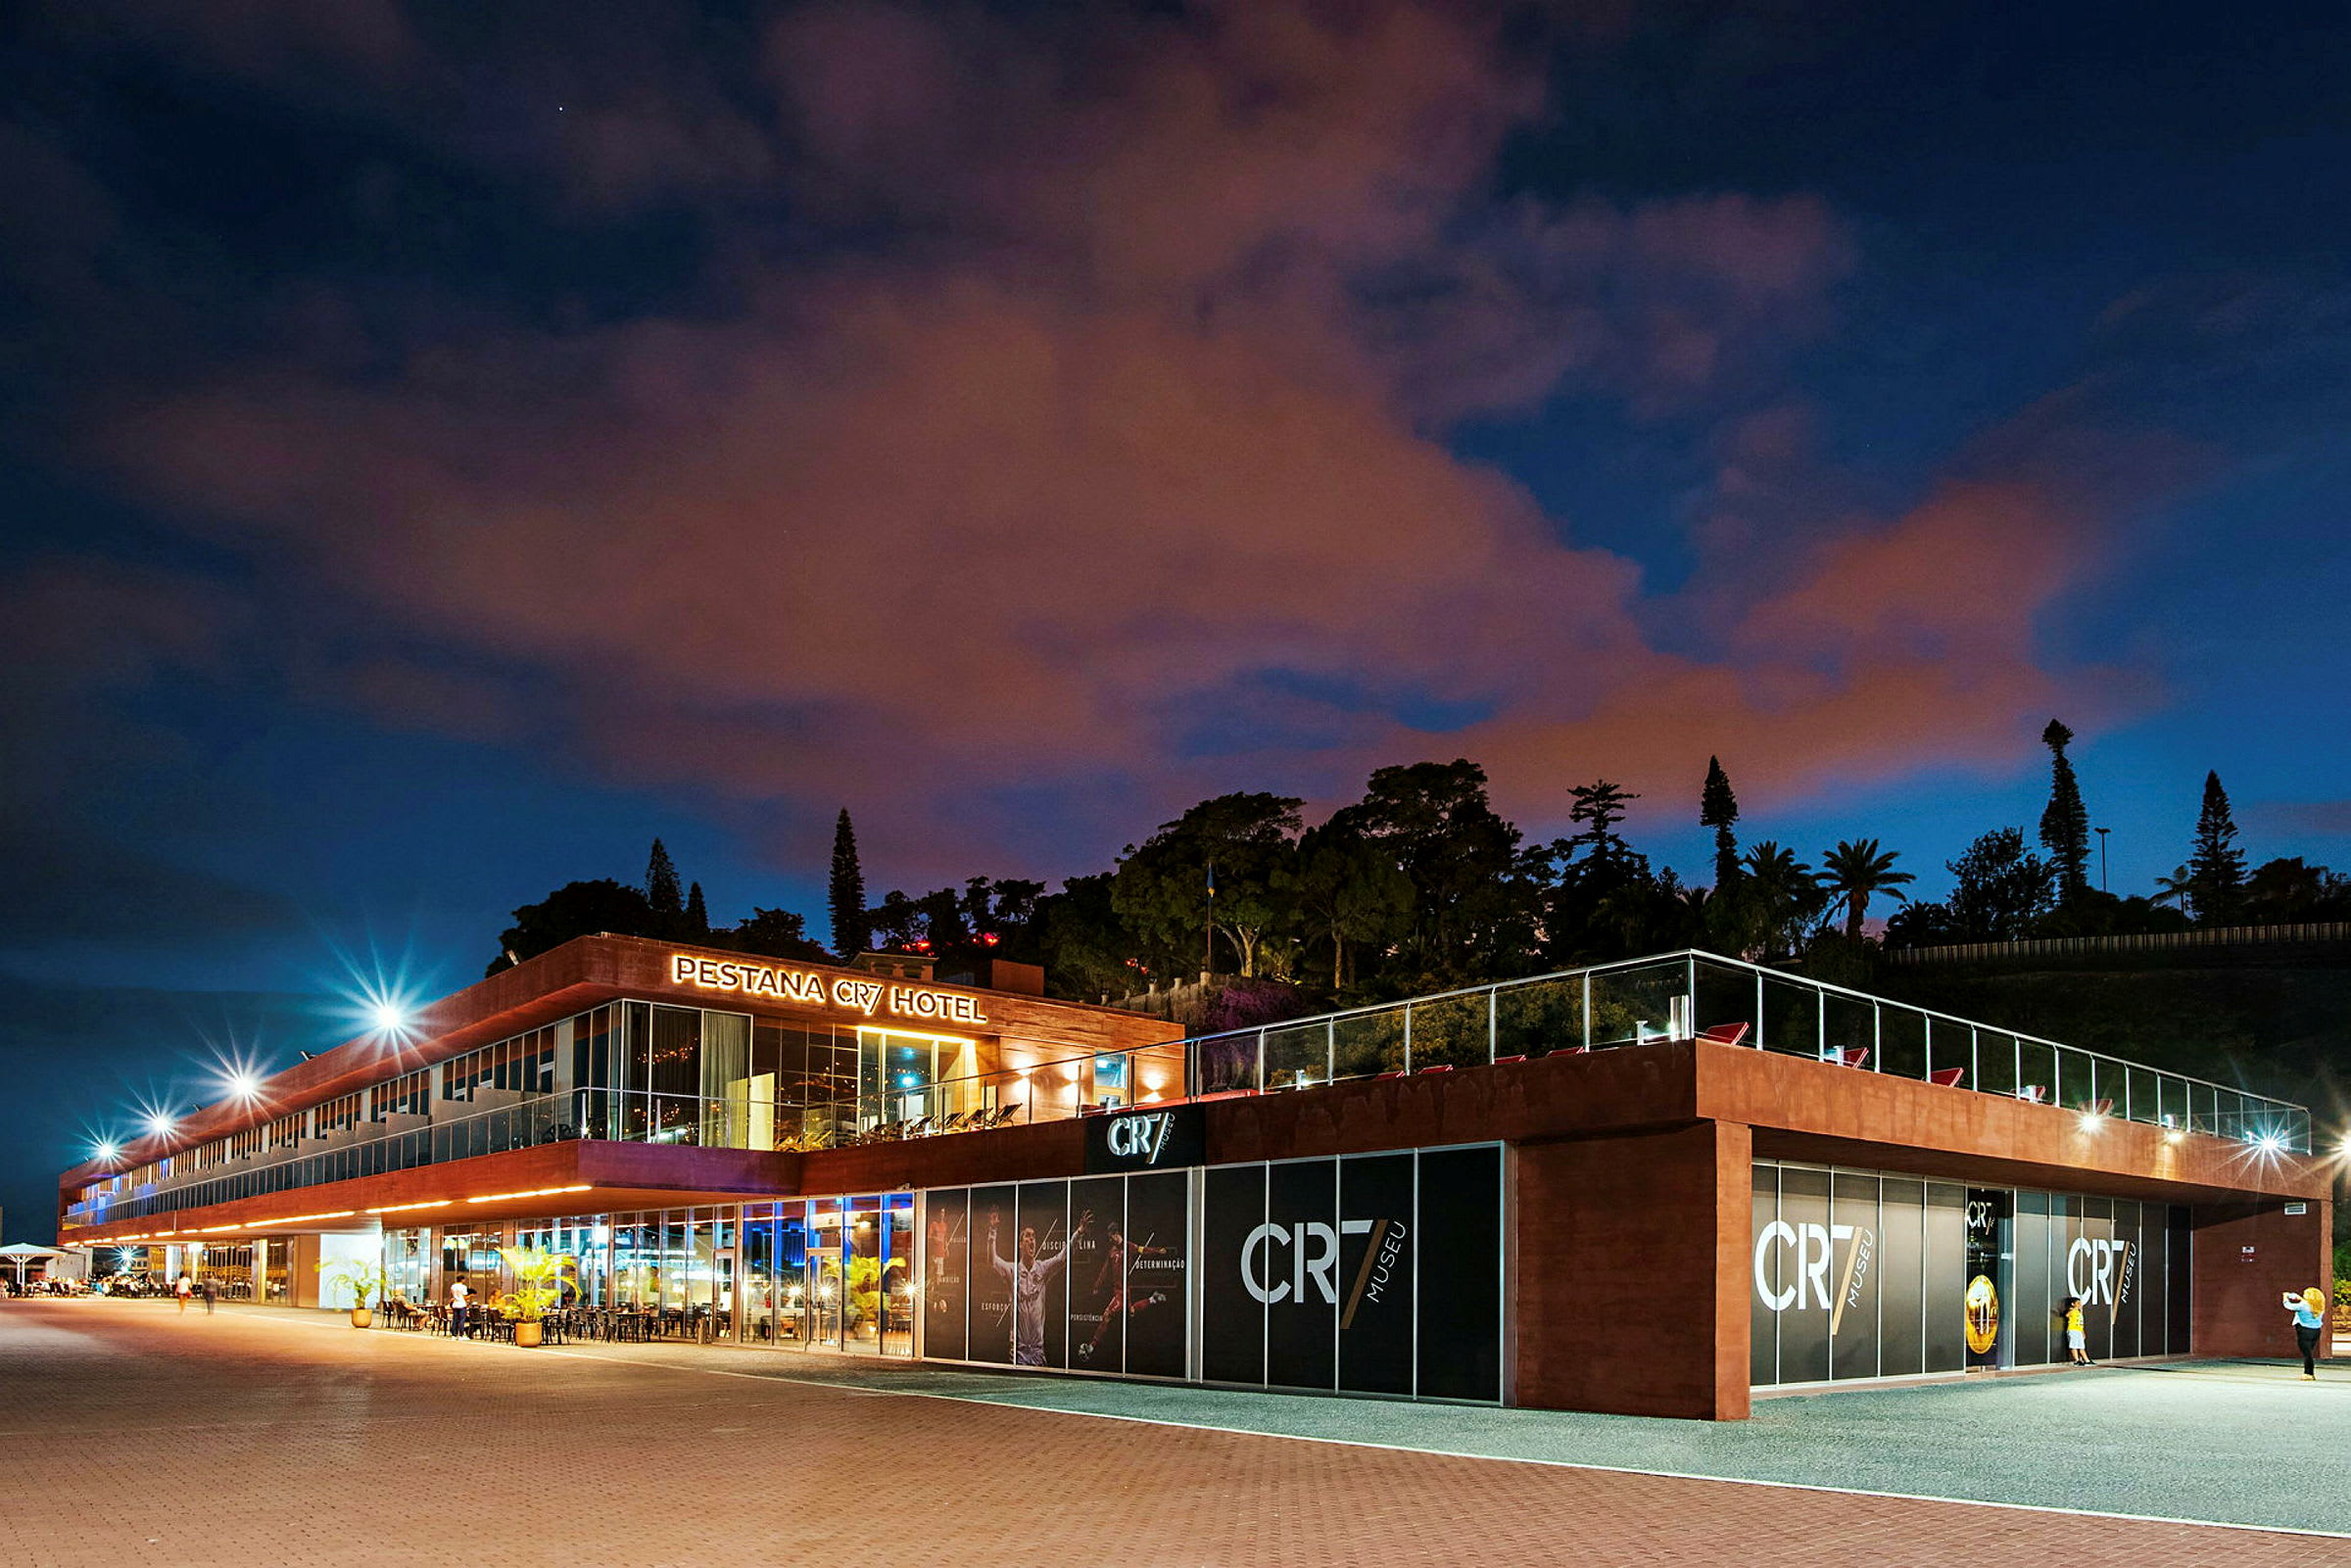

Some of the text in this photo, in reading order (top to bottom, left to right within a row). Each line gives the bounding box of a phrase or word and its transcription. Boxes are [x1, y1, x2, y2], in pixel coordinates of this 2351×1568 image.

[675, 956, 987, 1022] PESTANA CR7 HOTEL
[1107, 1111, 1170, 1164] CR7
[1160, 1114, 1176, 1150] MUSEU
[1968, 1201, 1993, 1235] CR7
[1240, 1219, 1388, 1329] CR7
[1367, 1220, 1407, 1303] MUSEU
[1754, 1220, 1862, 1335] CR7
[1847, 1229, 1873, 1307] MUSEU
[2067, 1237, 2130, 1324] CR7
[2121, 1242, 2136, 1304] MUSEU
